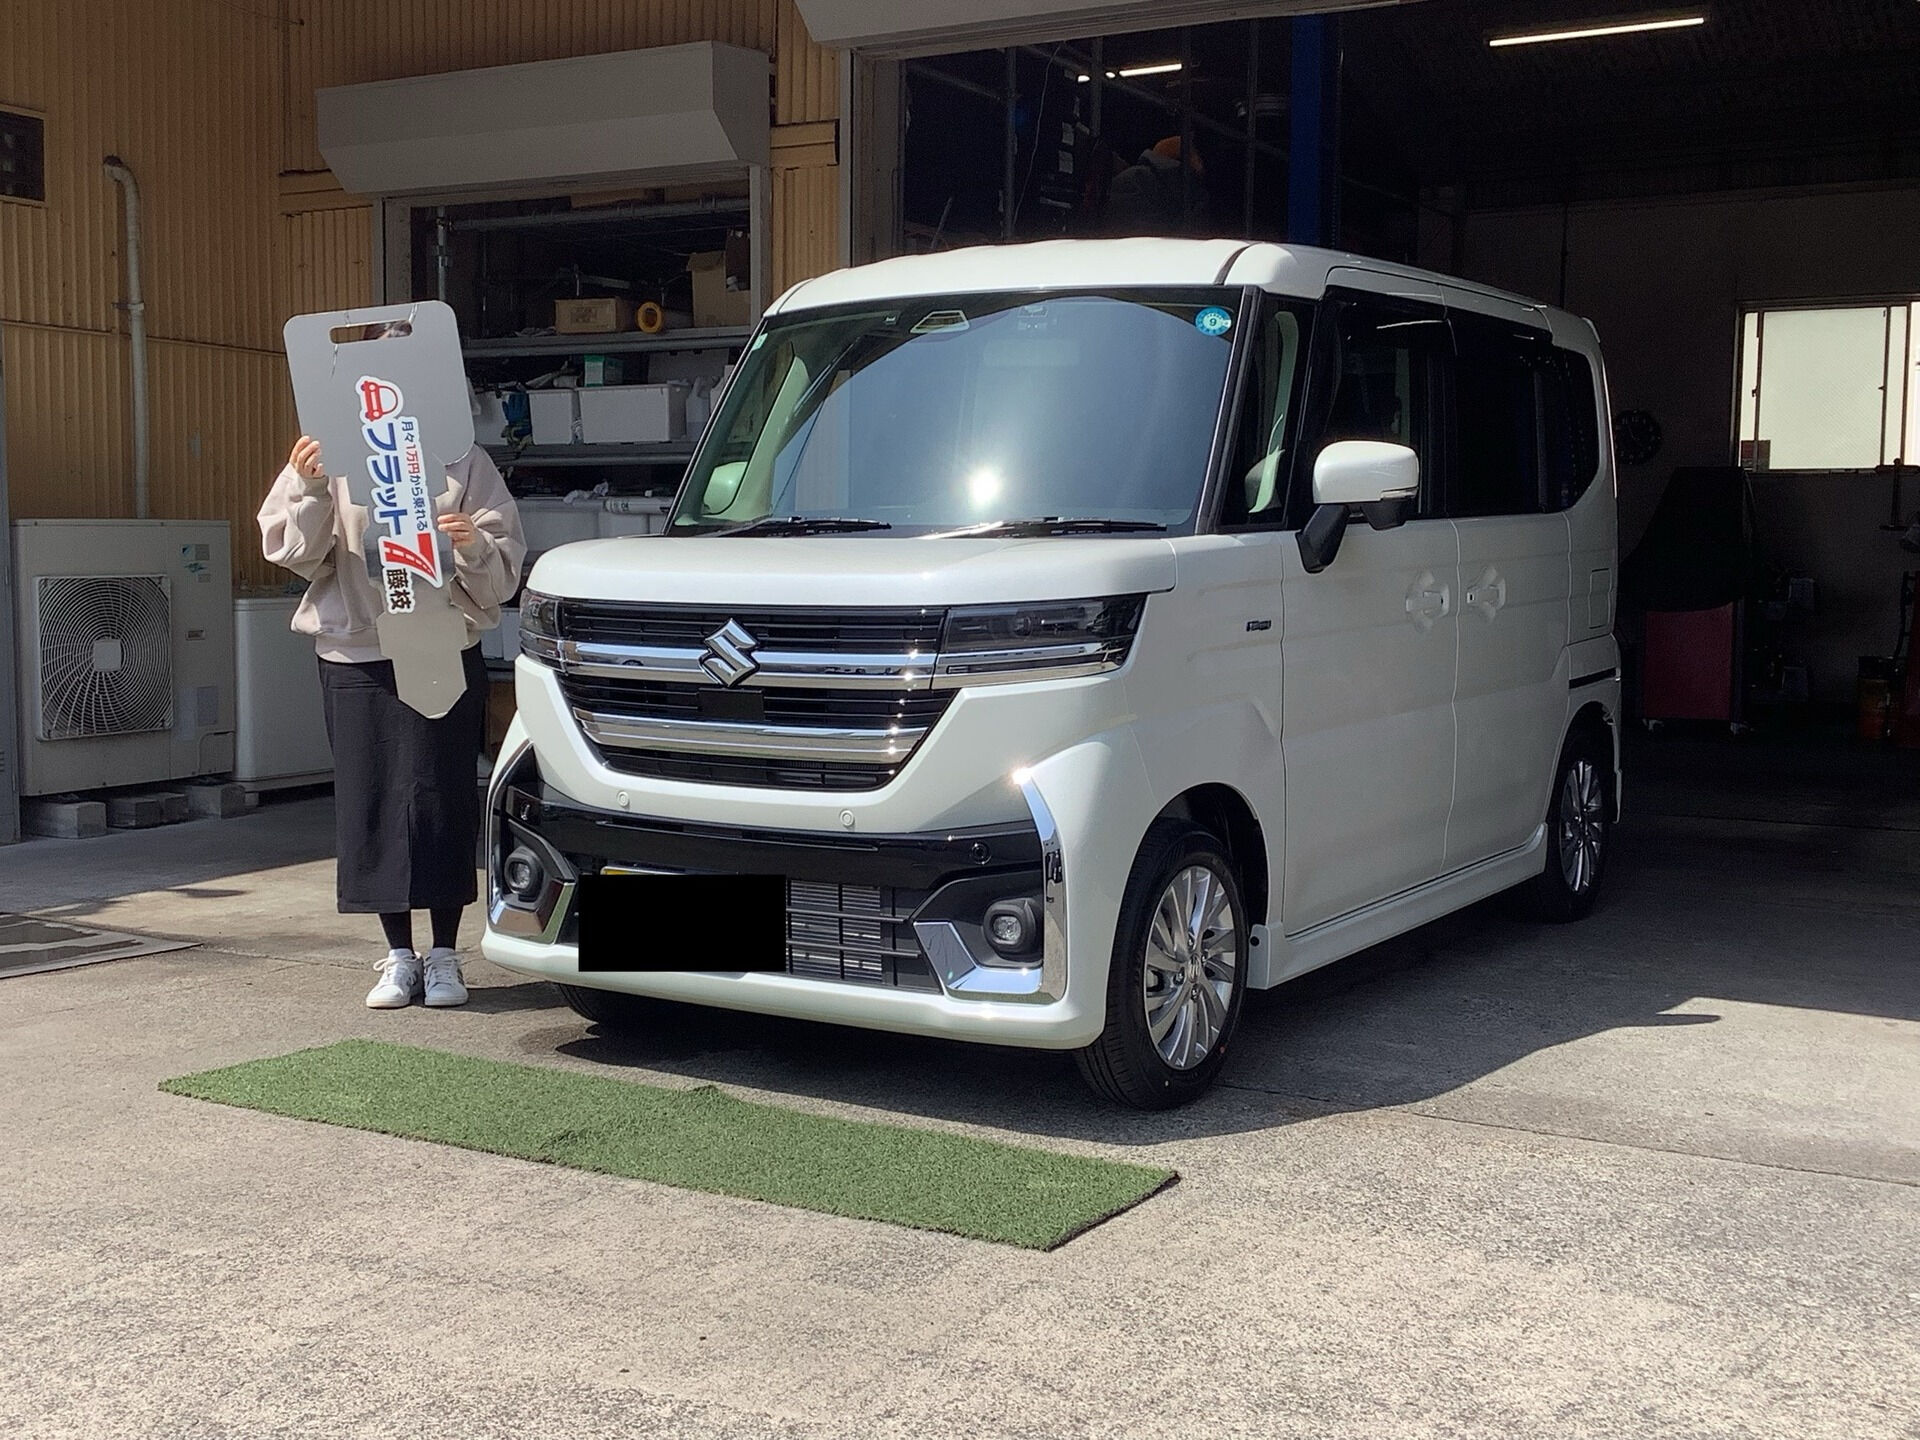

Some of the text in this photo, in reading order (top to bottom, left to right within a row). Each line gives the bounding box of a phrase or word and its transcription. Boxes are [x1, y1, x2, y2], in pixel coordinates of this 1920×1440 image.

[401, 421, 428, 531] 月々1万円から乗れる
[386, 567, 412, 610] 藤枝
